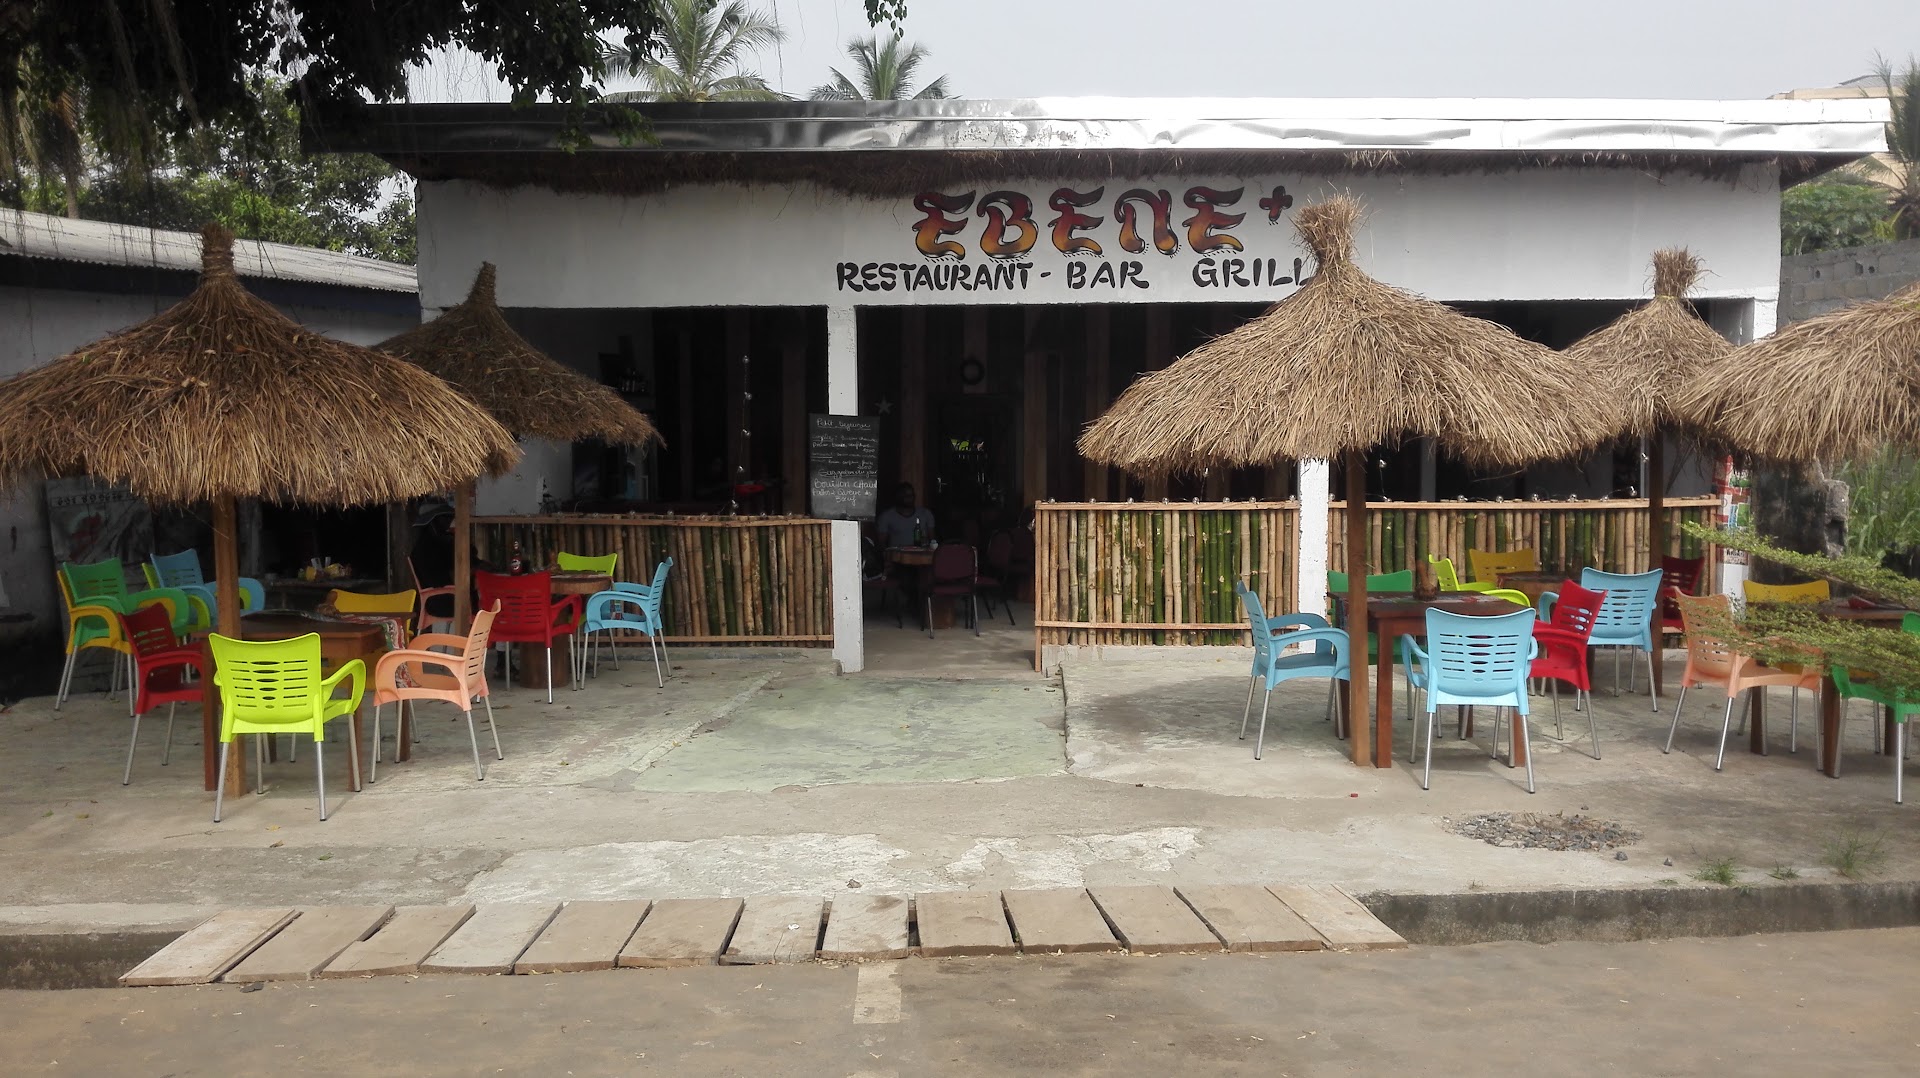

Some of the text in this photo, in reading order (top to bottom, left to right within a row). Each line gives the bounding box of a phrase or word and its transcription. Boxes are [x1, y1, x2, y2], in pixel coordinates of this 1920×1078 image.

[836, 261, 1034, 292] RESTAURANT
[1066, 261, 1150, 290] BAR
[1192, 257, 1315, 288] GRILL
